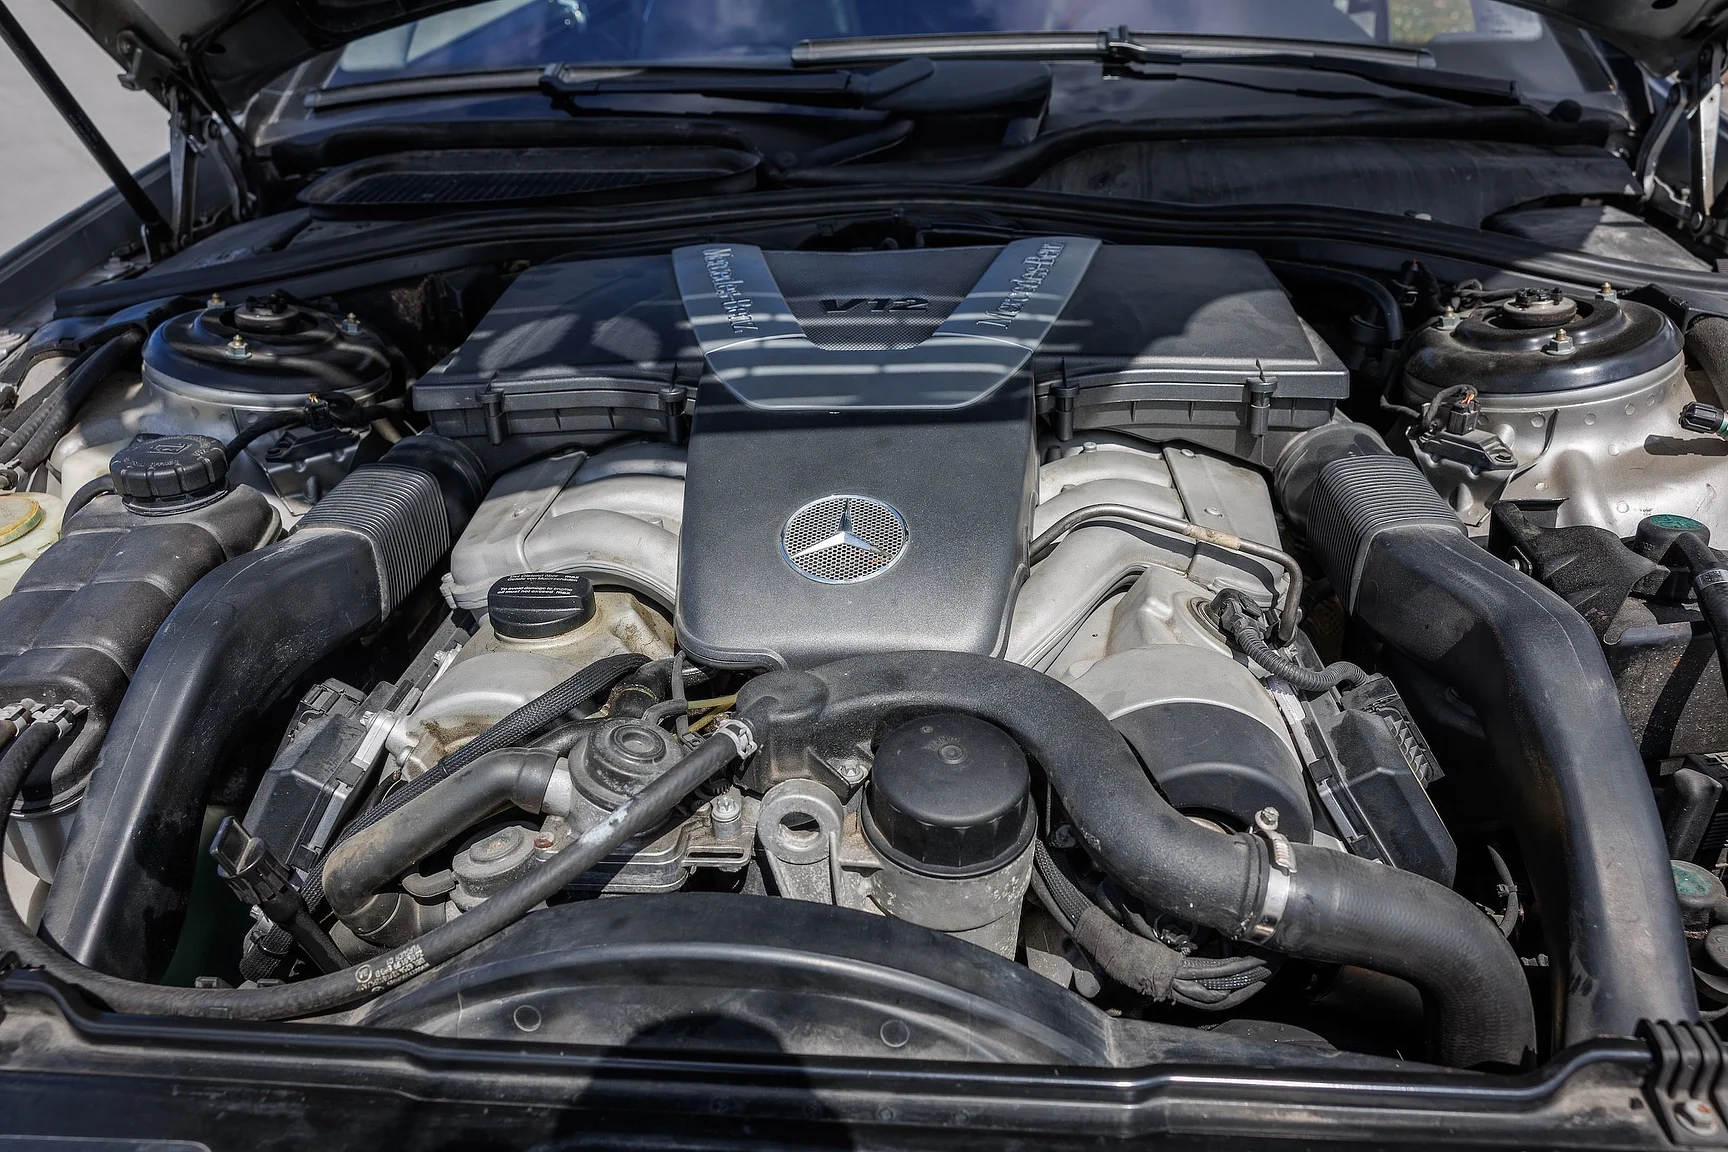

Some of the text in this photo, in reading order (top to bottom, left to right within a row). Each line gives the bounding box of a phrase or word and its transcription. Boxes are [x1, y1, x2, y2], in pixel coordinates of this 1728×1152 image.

[702, 248, 759, 334] Mercedes-Benz
[819, 298, 929, 314] V12
[974, 241, 1066, 330] Mercedes-Benz
